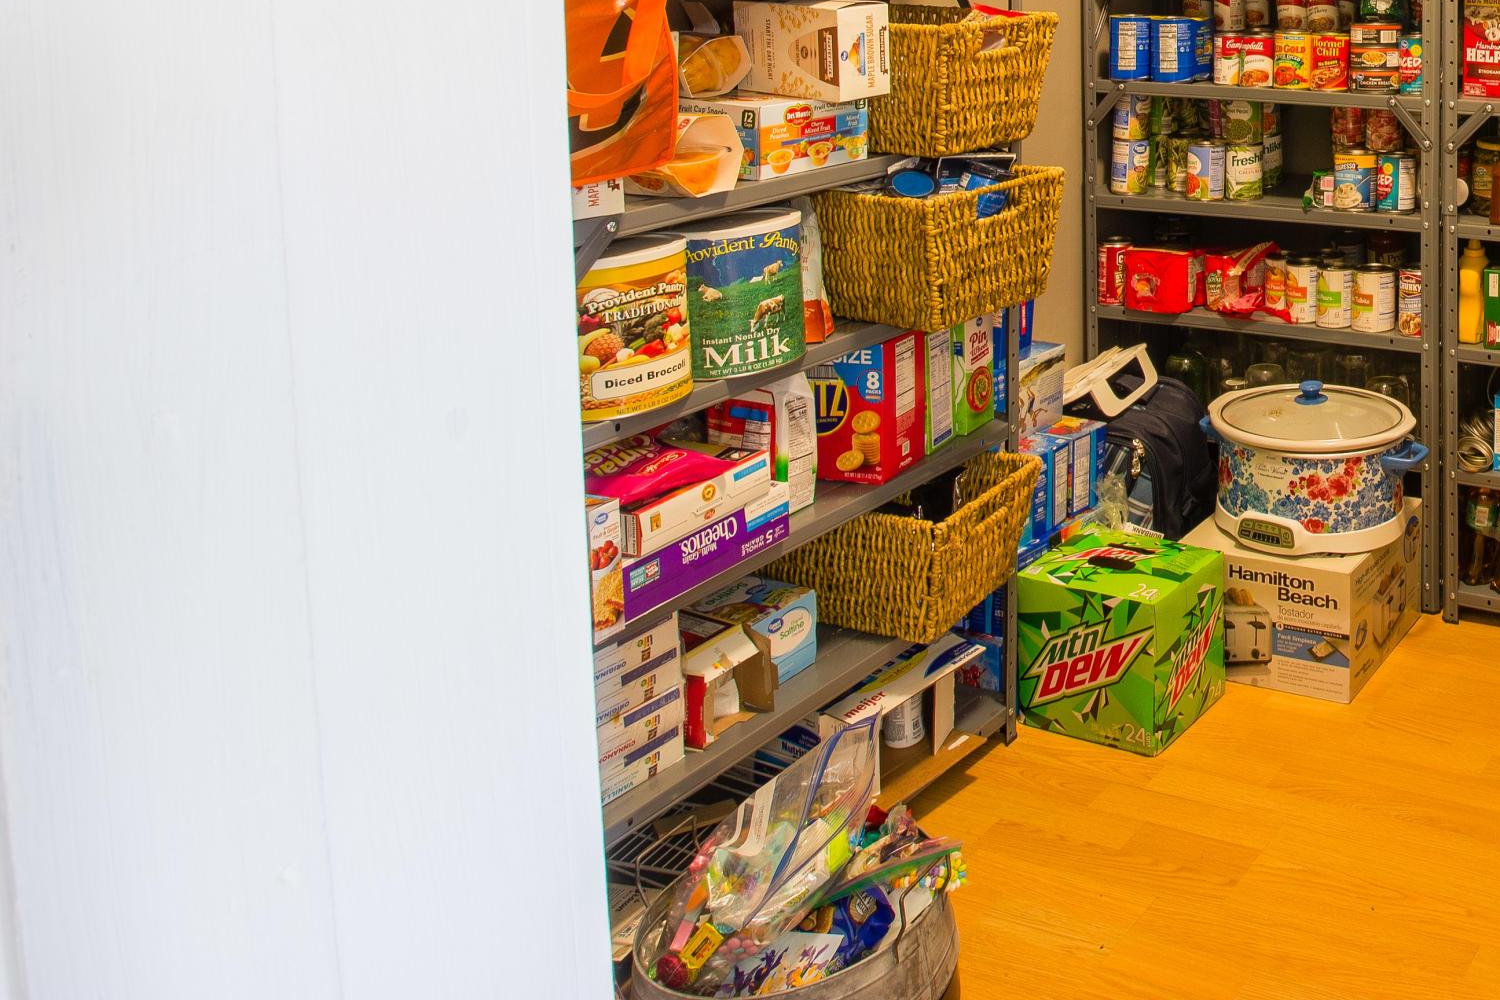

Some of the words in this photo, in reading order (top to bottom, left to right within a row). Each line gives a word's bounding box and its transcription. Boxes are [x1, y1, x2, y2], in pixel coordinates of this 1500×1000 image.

[865, 15, 874, 39] SUGAR
[866, 40, 875, 67] BROWN
[1316, 48, 1340, 57] Chili
[867, 69, 876, 88] MAPLE
[743, 113, 753, 123] 12
[1232, 155, 1261, 167] Fresh
[585, 286, 656, 316] Provident
[657, 282, 686, 296] Pantry
[703, 337, 731, 345] Instant
[734, 330, 765, 343] Nonfat
[766, 326, 781, 336] Dry
[969, 330, 987, 346] Pin
[703, 334, 791, 369] Milk
[605, 375, 643, 390] Diced
[647, 359, 686, 380] Broccoli
[866, 371, 880, 390] 8
[681, 516, 738, 556] Cheerios
[765, 530, 774, 543] 5
[1229, 564, 1315, 592] Hamilton
[1277, 587, 1338, 610] Beach
[1277, 605, 1314, 619] Tostador
[779, 620, 805, 640] Saltine
[843, 689, 887, 719] meijer
